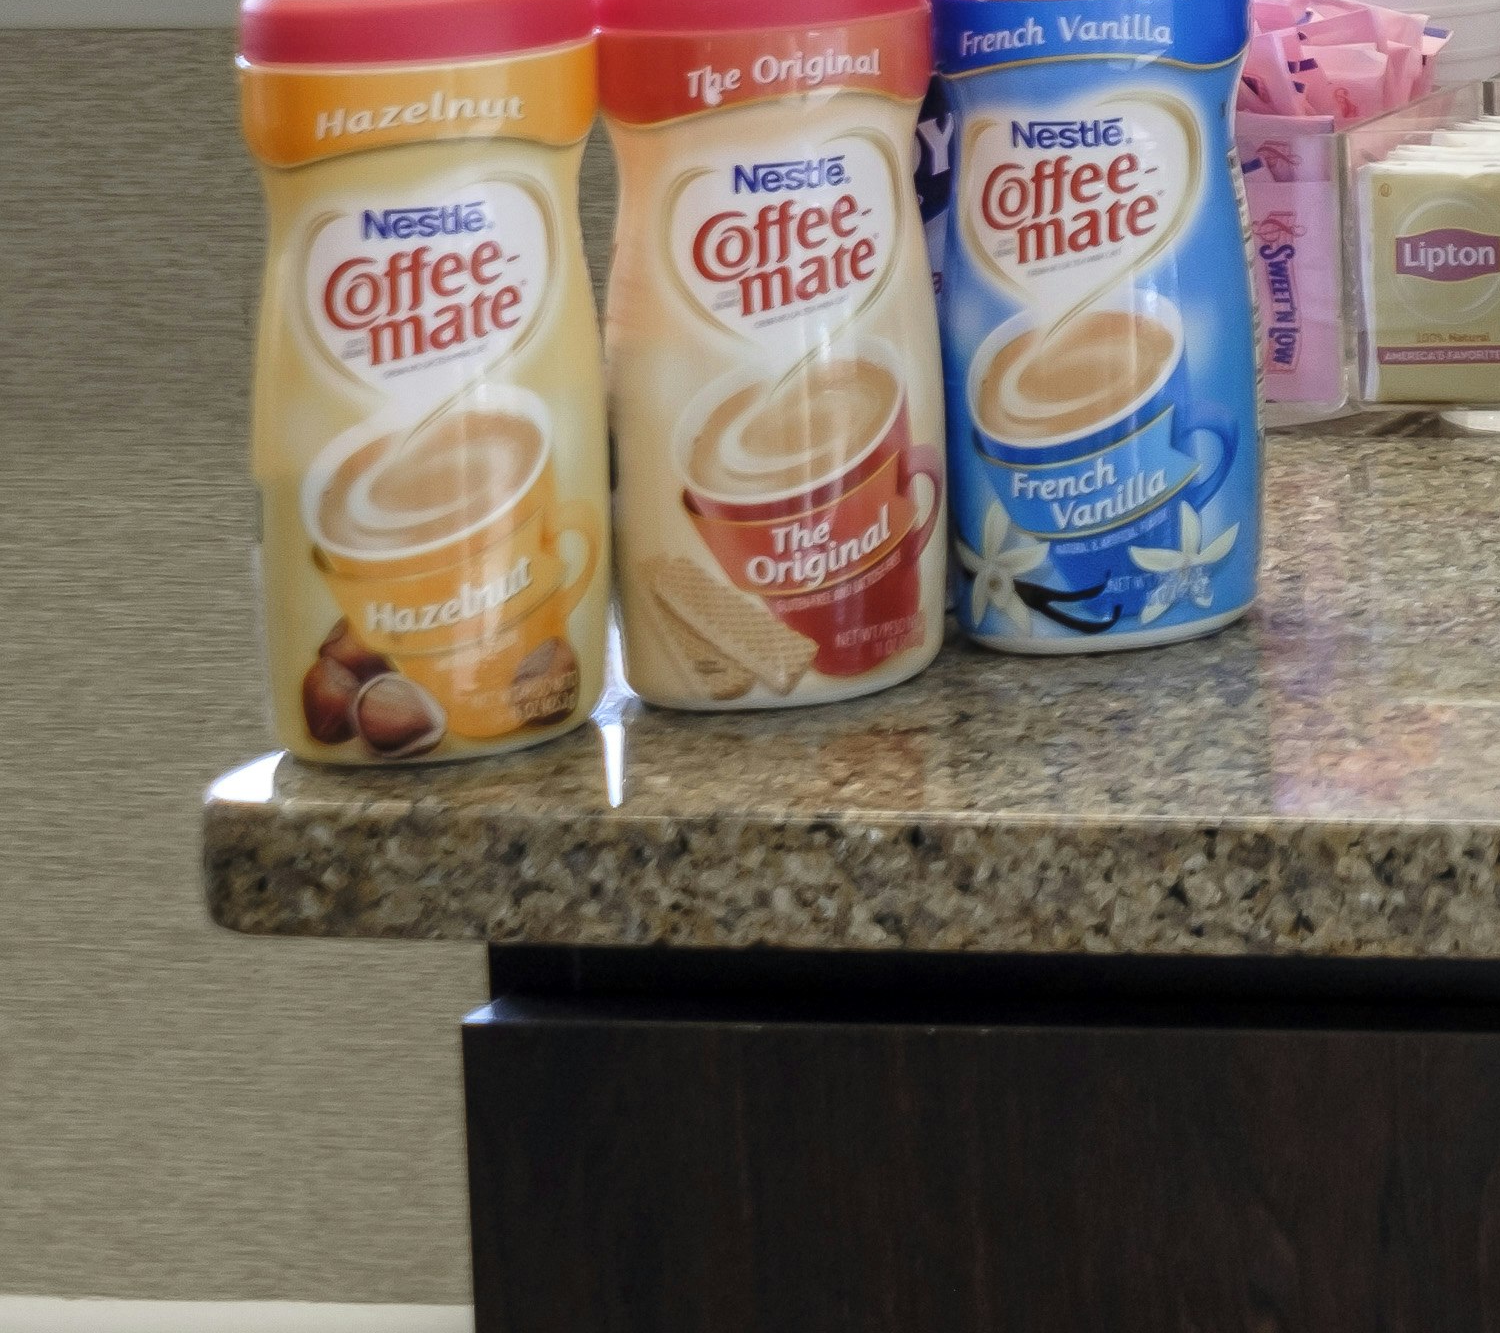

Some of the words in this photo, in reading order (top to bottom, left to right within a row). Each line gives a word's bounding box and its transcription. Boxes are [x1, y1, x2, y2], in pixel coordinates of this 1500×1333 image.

[961, 17, 1045, 57] French
[1057, 13, 1174, 45] Vanilla
[687, 66, 741, 99] The
[752, 48, 882, 85] Original
[315, 91, 527, 141] Hazelnut
[1016, 195, 1160, 265] mate
[738, 237, 876, 318] mate
[1404, 241, 1496, 273] Lipton
[368, 284, 523, 367] mate
[1446, 349, 1500, 361] FAVORITE
[1011, 457, 1118, 500] French
[1051, 469, 1168, 530] Vanilla
[746, 502, 891, 589] Original
[771, 520, 831, 556] The
[363, 556, 533, 635] Hazelnut
